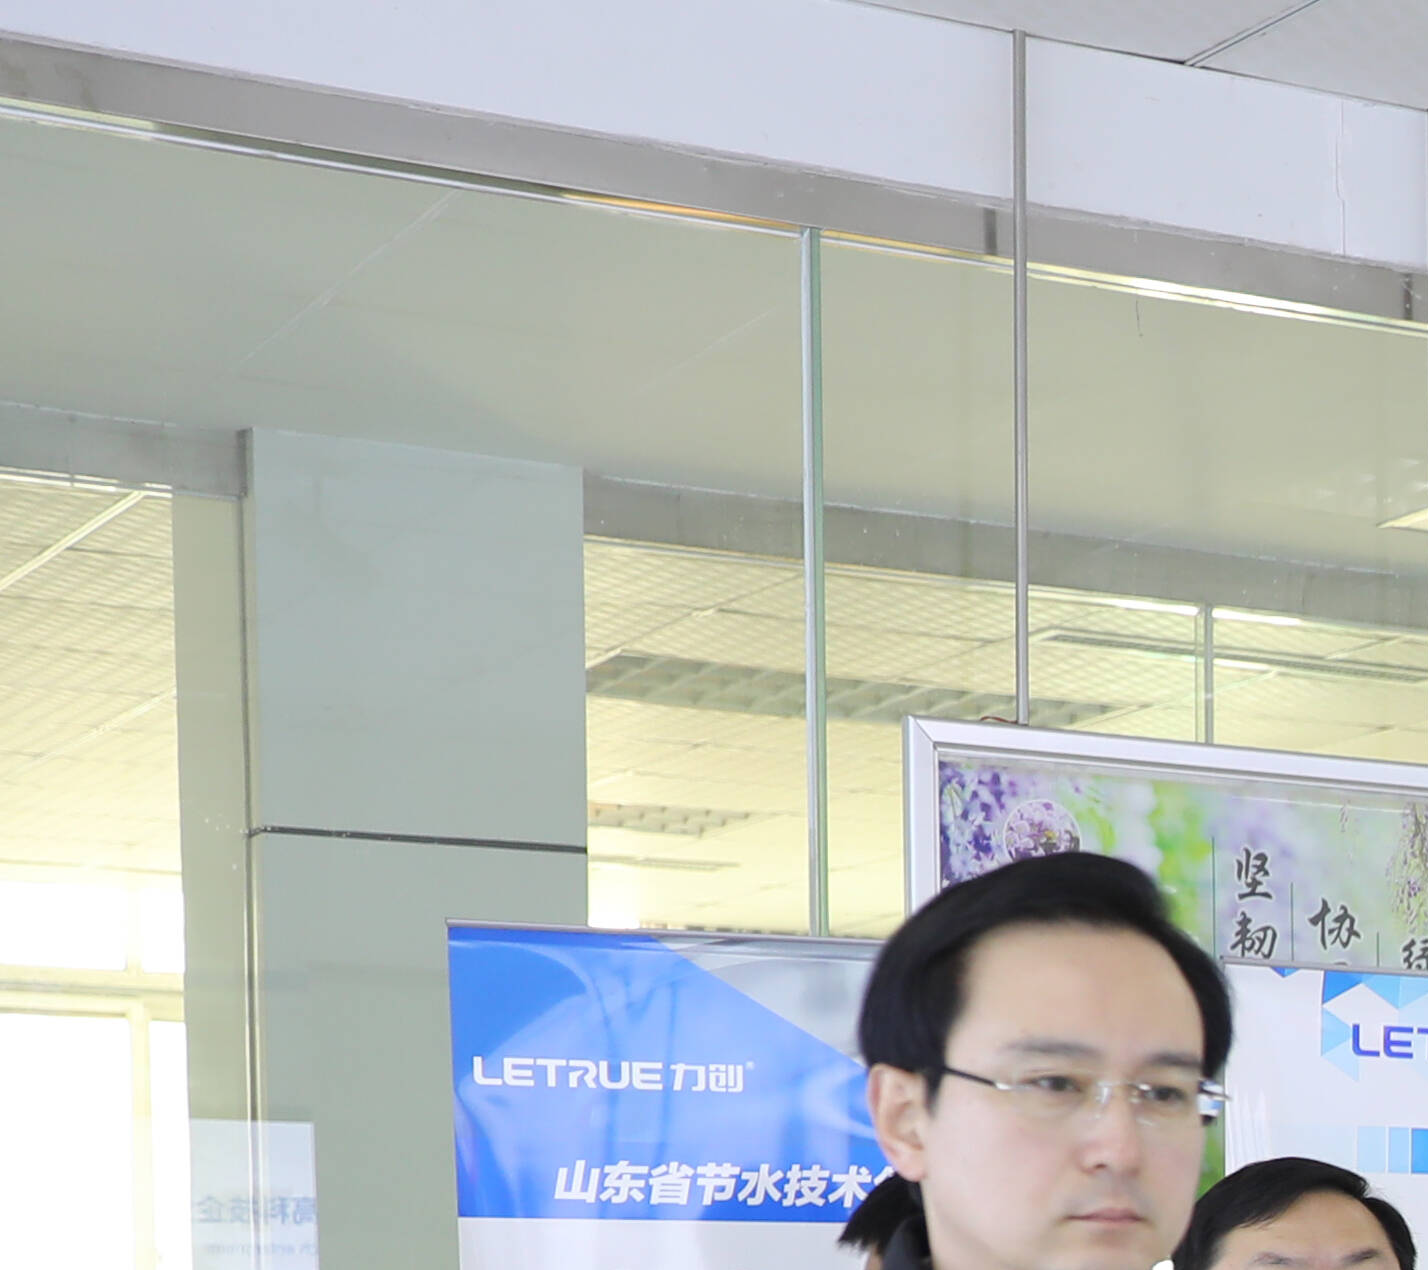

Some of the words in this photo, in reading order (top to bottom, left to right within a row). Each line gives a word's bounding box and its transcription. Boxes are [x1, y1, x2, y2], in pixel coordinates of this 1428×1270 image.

[1230, 847, 1277, 958] 坚韧
[1309, 898, 1362, 968] 协
[474, 1056, 662, 1091] LETRUE
[670, 1062, 744, 1093] 力创
